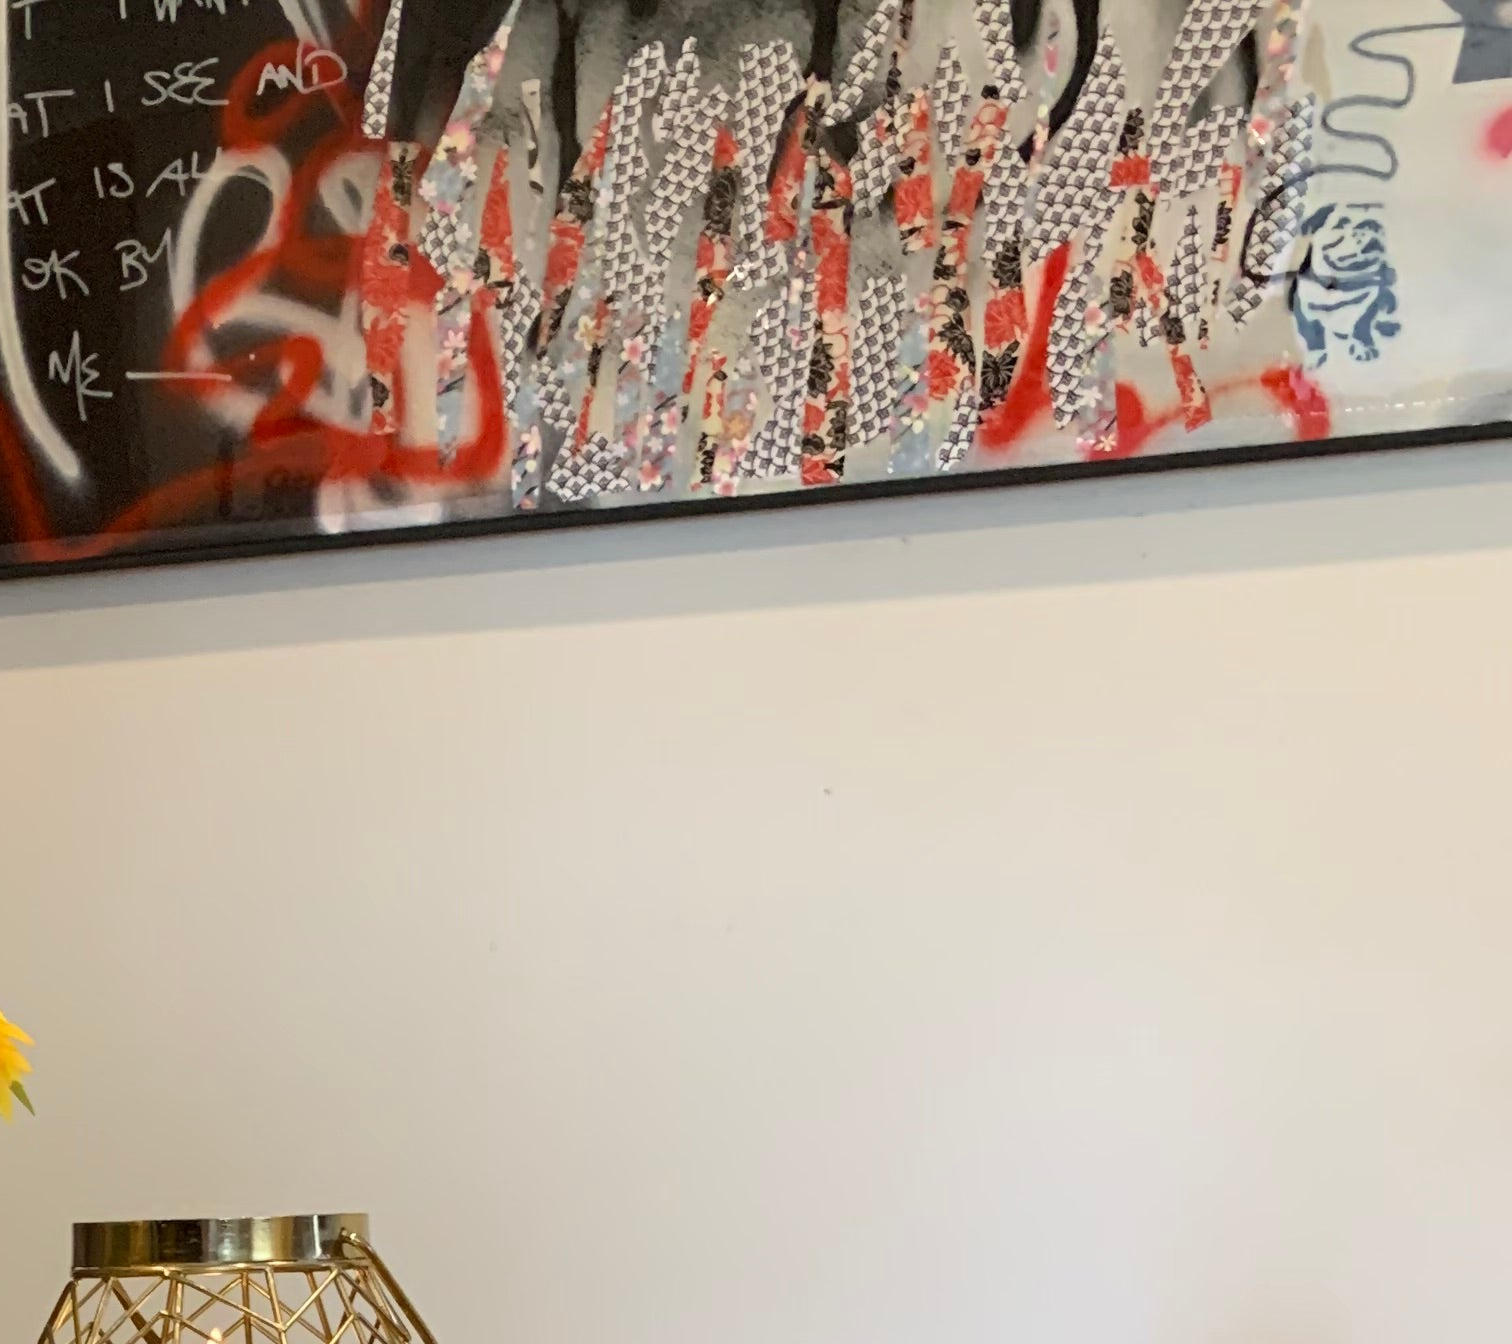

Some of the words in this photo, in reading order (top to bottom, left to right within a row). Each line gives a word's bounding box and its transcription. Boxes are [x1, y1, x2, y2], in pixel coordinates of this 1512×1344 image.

[141, 57, 230, 107] SEE
[255, 42, 348, 96] AND
[94, 162, 135, 199] IS
[48, 331, 113, 421] ME
